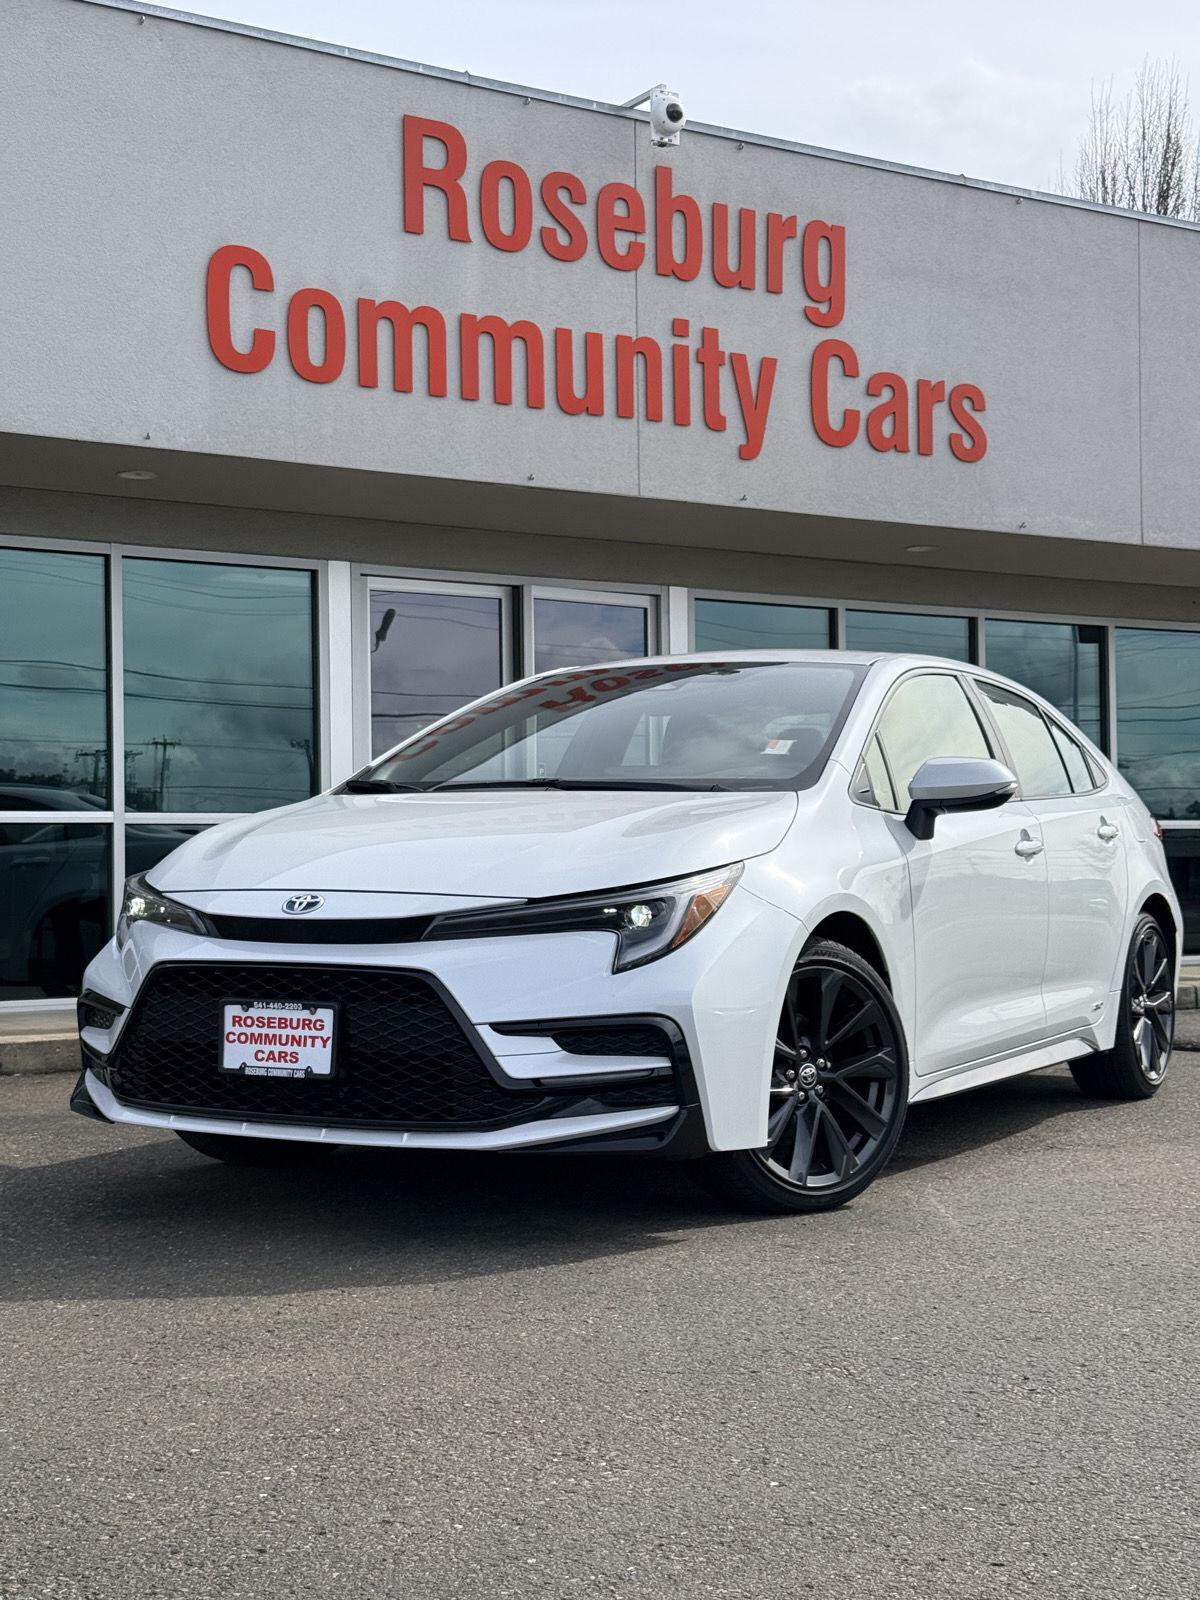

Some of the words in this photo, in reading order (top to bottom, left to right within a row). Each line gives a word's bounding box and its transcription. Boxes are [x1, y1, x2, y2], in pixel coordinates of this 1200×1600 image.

[402, 114, 846, 328] Roseburg
[205, 244, 778, 461] Community
[809, 338, 988, 462] Cars
[253, 1001, 303, 1010] 541-440-2203
[231, 1015, 325, 1031] ROSEBURG
[225, 1032, 331, 1048] COMMUNITY
[254, 1049, 300, 1064] CARS
